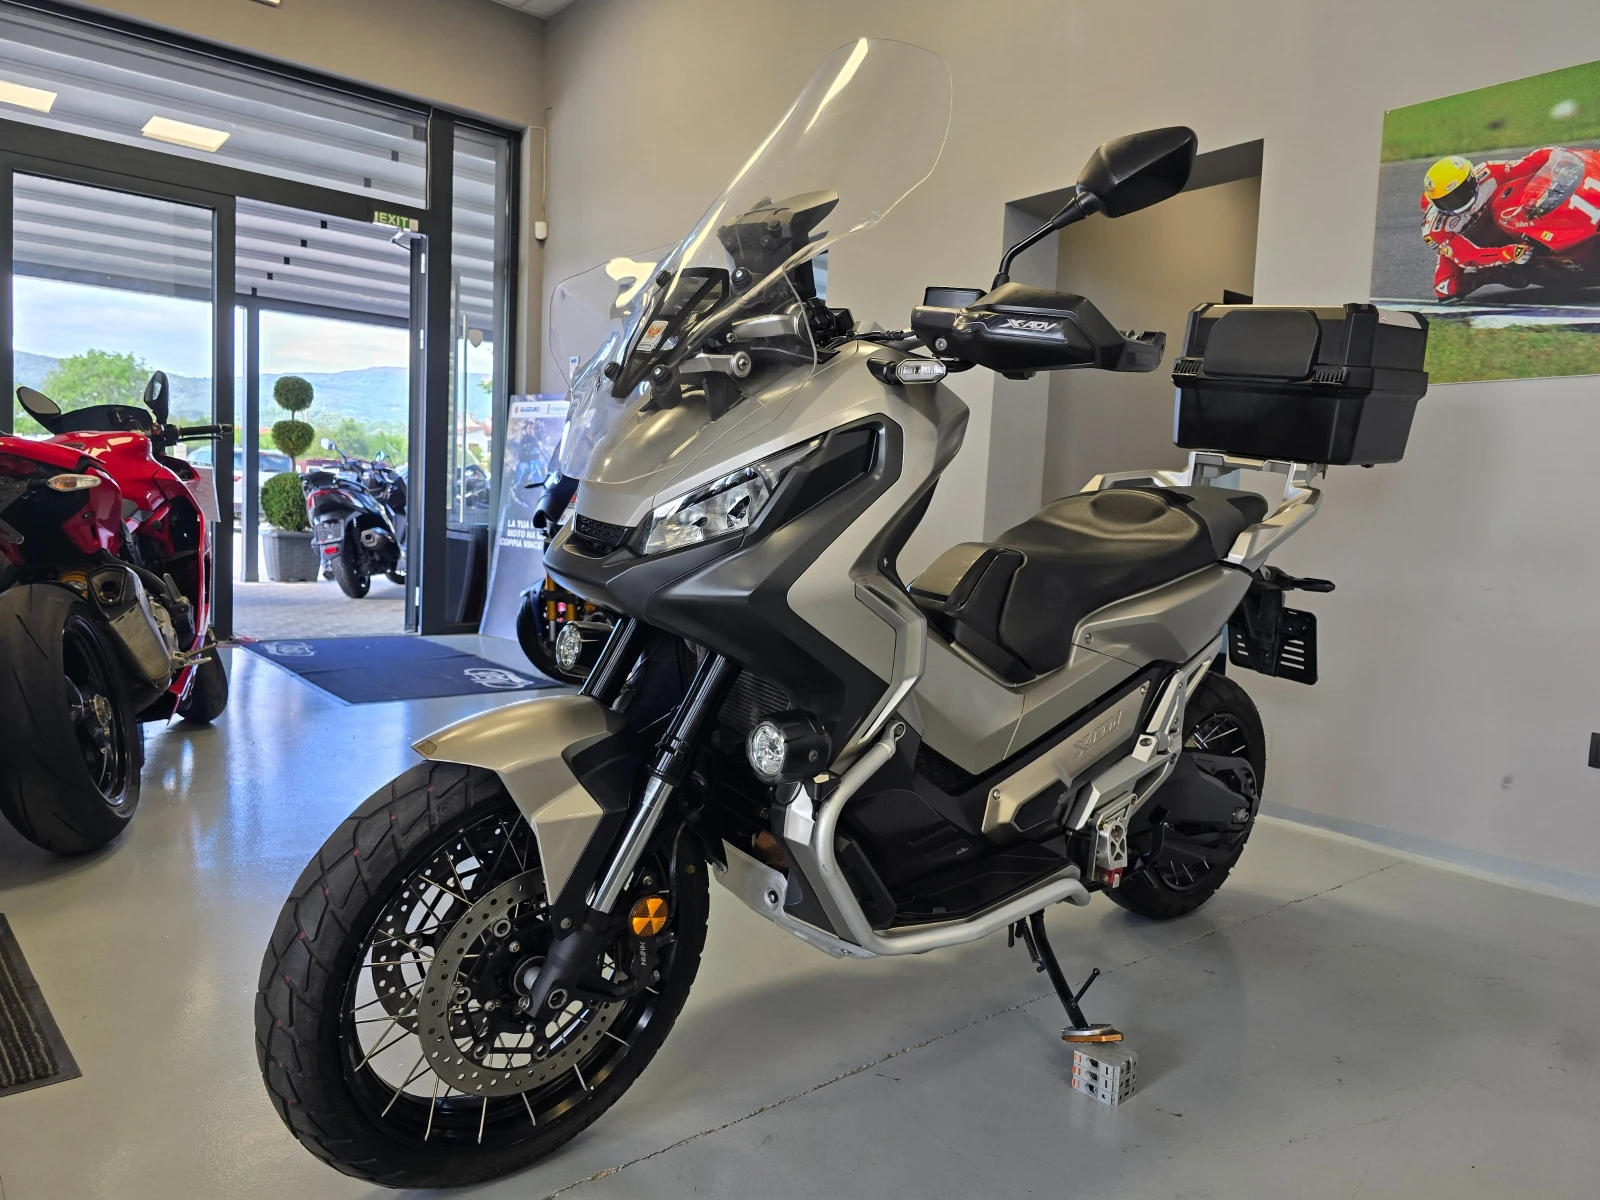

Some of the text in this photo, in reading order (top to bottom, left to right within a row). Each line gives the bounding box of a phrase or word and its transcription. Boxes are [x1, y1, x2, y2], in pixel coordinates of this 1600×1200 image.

[379, 211, 409, 229] EXIT
[507, 518, 516, 528] LA
[517, 519, 530, 529] TUA
[507, 528, 526, 538] MOTO
[526, 530, 536, 540] HA
[500, 537, 522, 548] COPPIA
